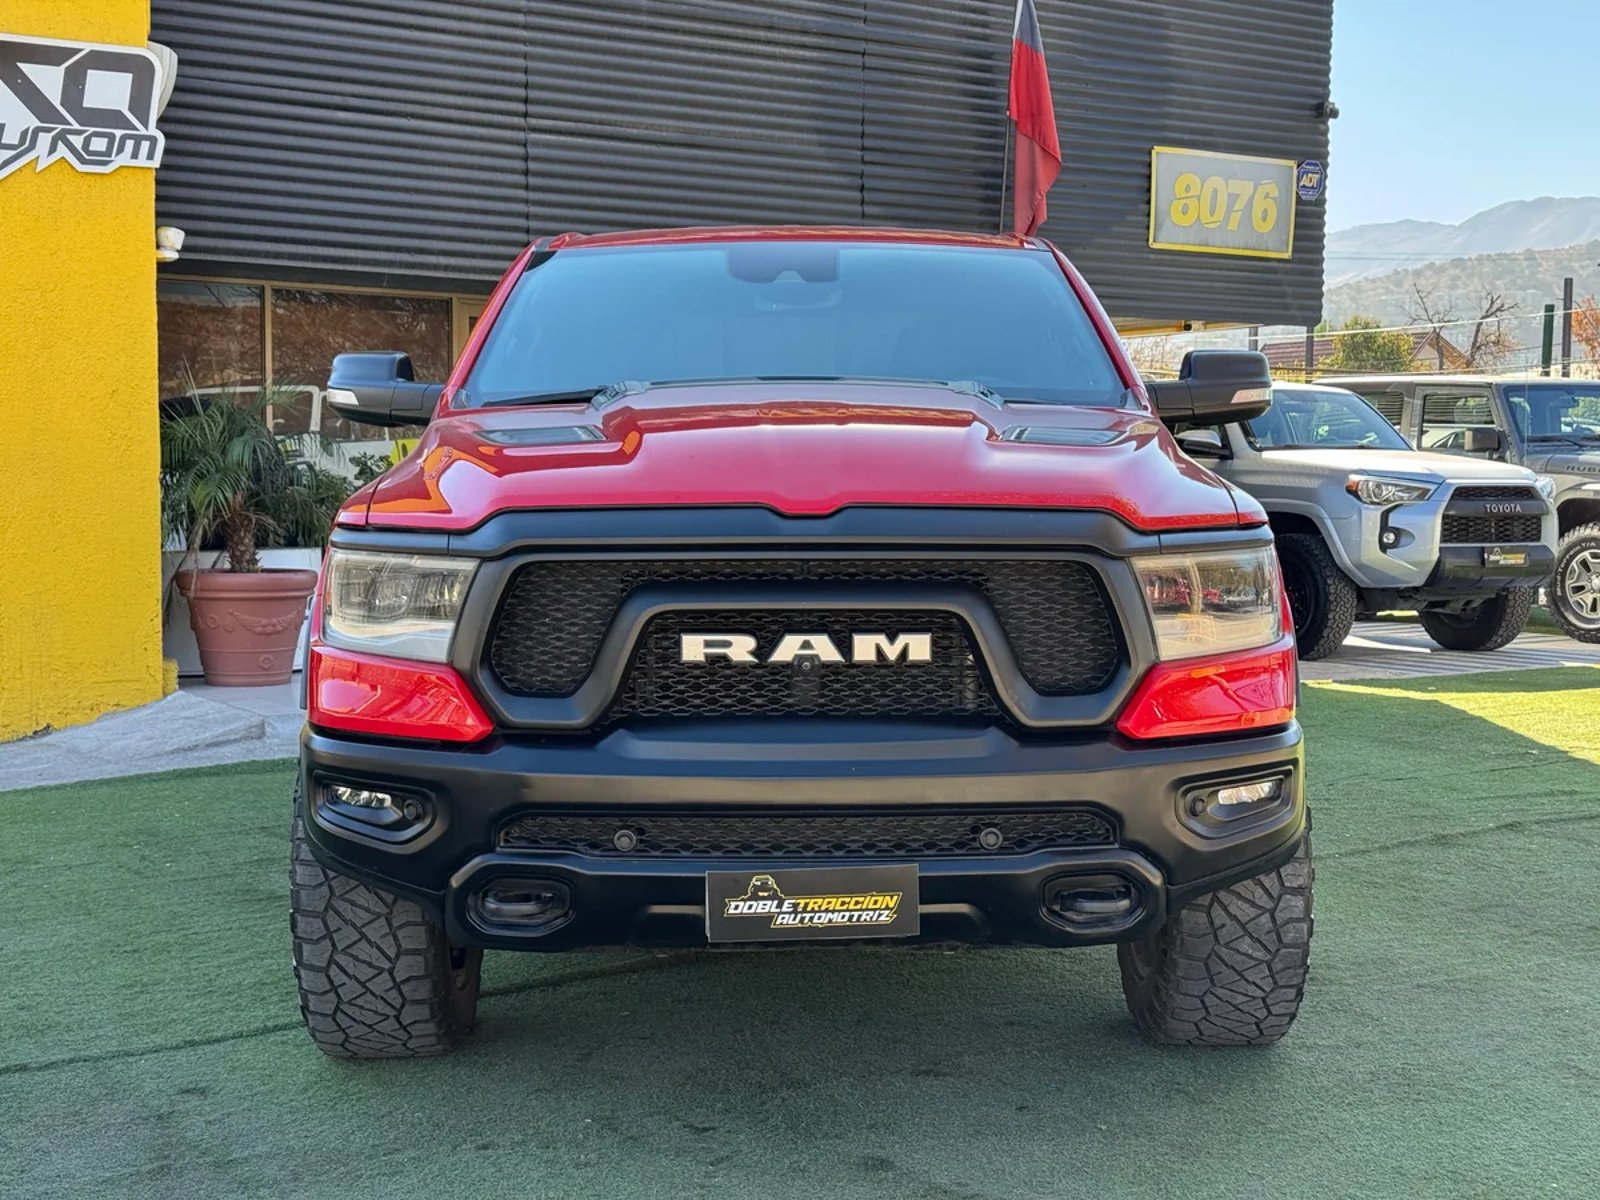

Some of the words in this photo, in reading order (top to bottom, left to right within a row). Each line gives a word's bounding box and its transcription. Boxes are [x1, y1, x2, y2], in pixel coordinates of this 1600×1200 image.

[1299, 172, 1320, 188] ADT
[1170, 172, 1279, 233] 8076
[1485, 503, 1522, 513] TOYOTA
[680, 633, 932, 663] RAM
[775, 910, 891, 925] AUTOMOTRIZ
